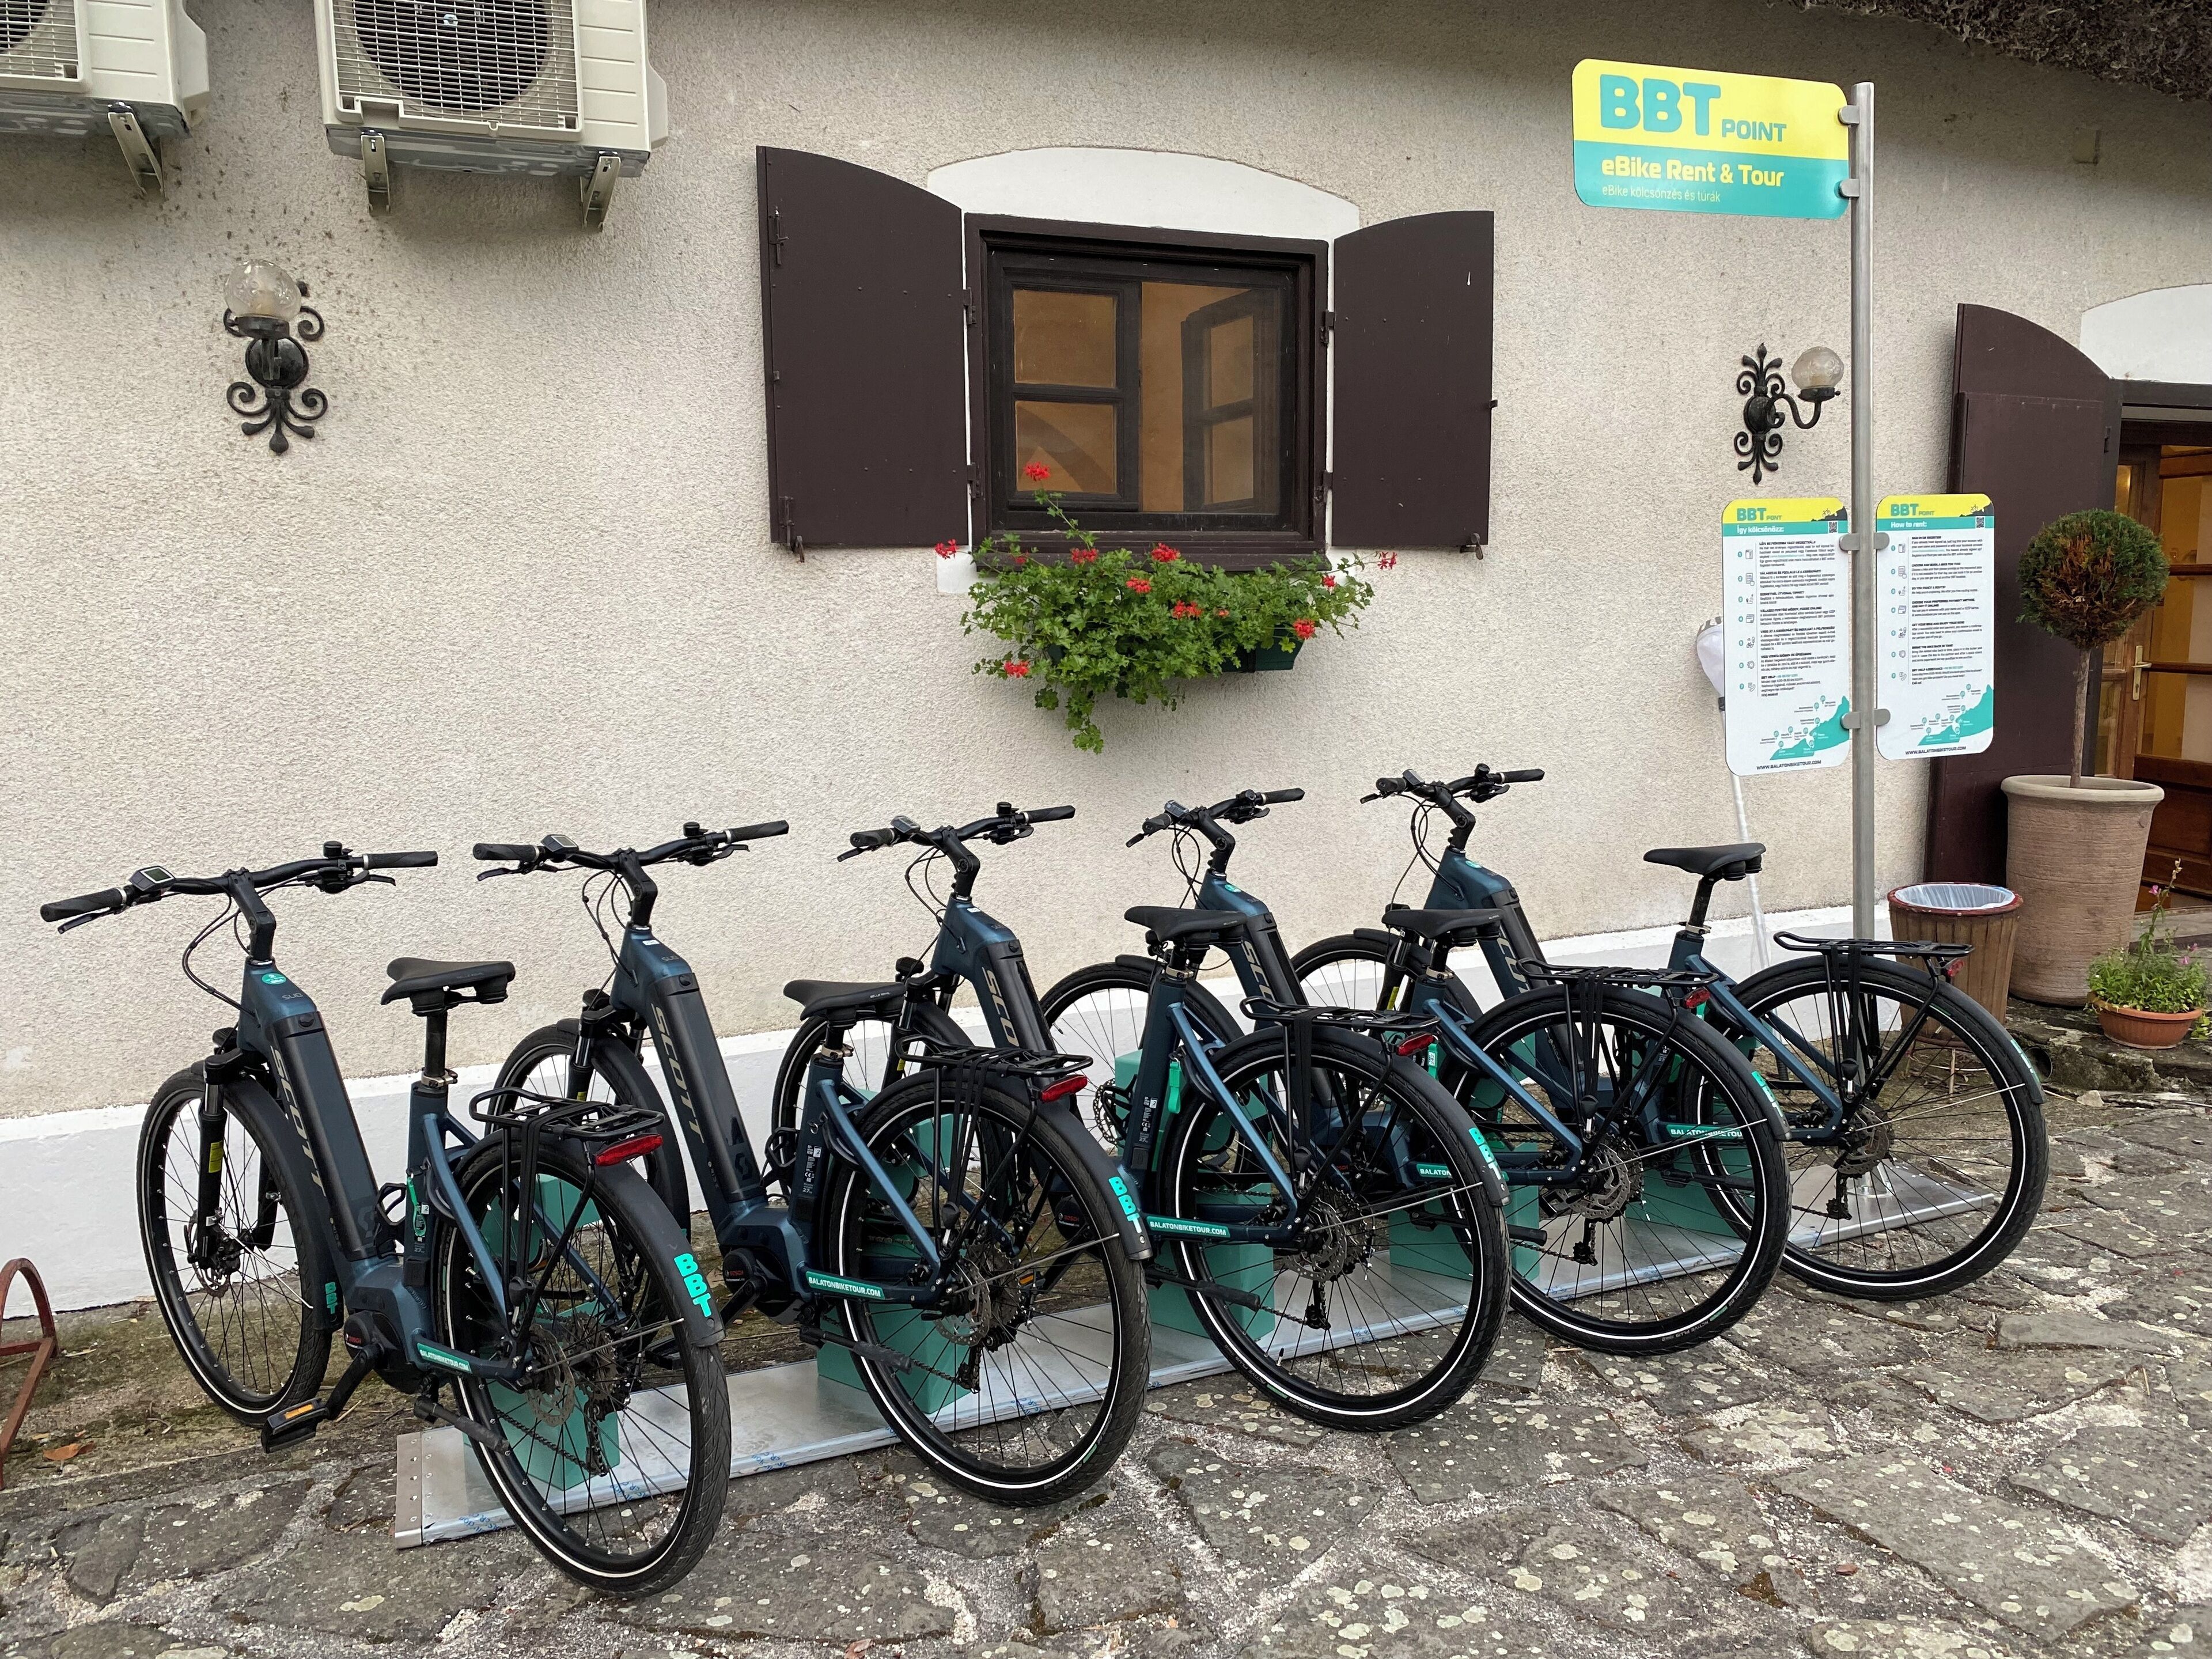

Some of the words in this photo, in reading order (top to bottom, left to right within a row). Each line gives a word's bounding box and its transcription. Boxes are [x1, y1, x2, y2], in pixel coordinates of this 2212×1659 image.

[1600, 74, 1721, 136] BBT
[1721, 119, 1787, 142] POINT
[1601, 155, 1662, 179] eBike
[1666, 158, 1716, 182] Rent
[1720, 163, 1734, 184] &
[1737, 164, 1785, 187] Tour
[1602, 185, 1628, 197] eBike
[1684, 188, 1695, 200] és
[1737, 507, 1767, 521] BBT
[1891, 503, 1919, 516] BBT
[1241, 940, 1280, 1012] SCO
[982, 967, 1020, 1047] SCO
[651, 1002, 704, 1144] SCOTT
[270, 1045, 327, 1198] SCOTT
[1419, 1168, 1452, 1176] BALATON
[1468, 1127, 1502, 1180] BBT
[1108, 1176, 1142, 1233] BBT
[1150, 1221, 1226, 1236] BALATONBIKETOUR.COM
[325, 1282, 338, 1315] BBT
[673, 1253, 712, 1317] BBT
[808, 1277, 881, 1297] BALATONBIKETOUR.COM
